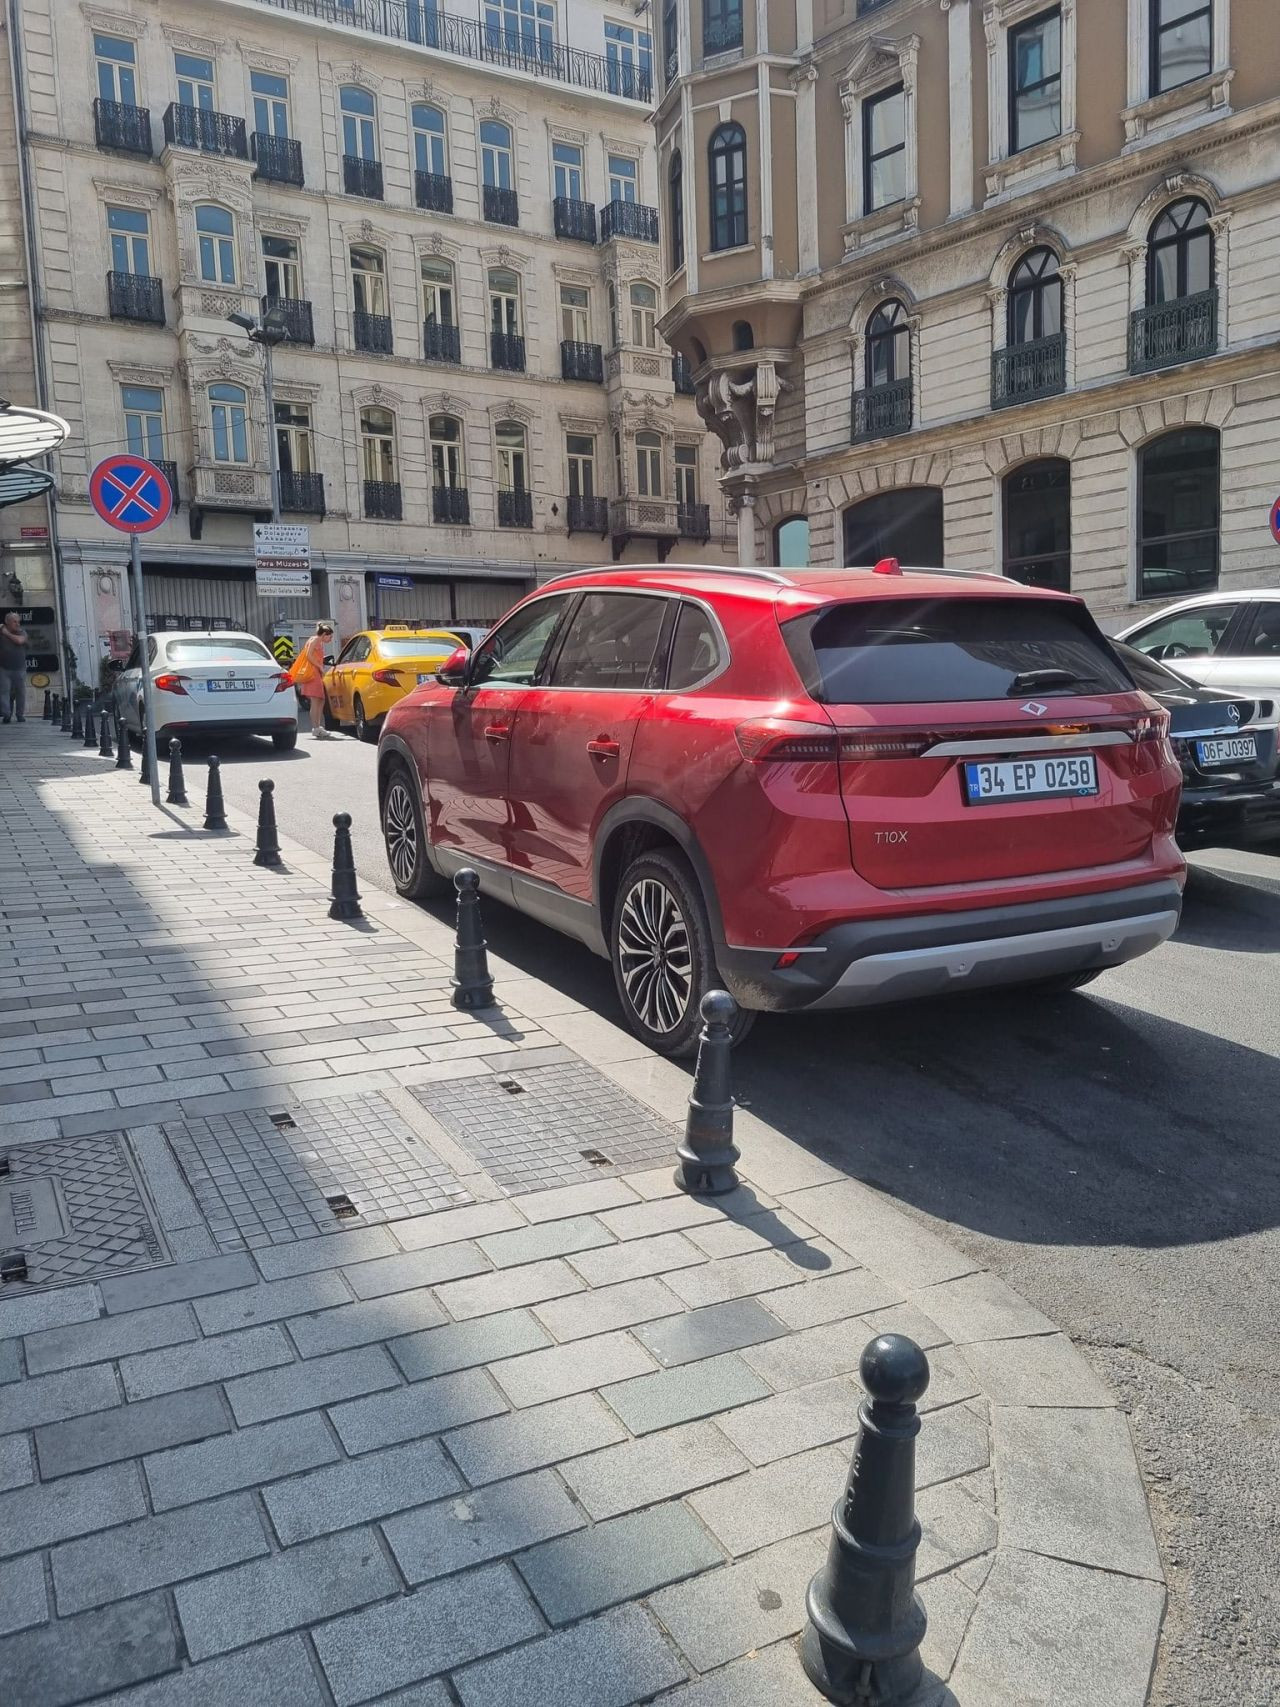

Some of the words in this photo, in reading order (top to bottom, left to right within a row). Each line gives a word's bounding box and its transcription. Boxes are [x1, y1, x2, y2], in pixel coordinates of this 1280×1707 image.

[212, 680, 222, 689] 34
[225, 680, 238, 689] DPL
[969, 783, 979, 793] TR
[980, 765, 1005, 794] 34
[1012, 762, 1037, 792] EP
[1044, 759, 1091, 788] 0258
[874, 830, 909, 844] T10X
